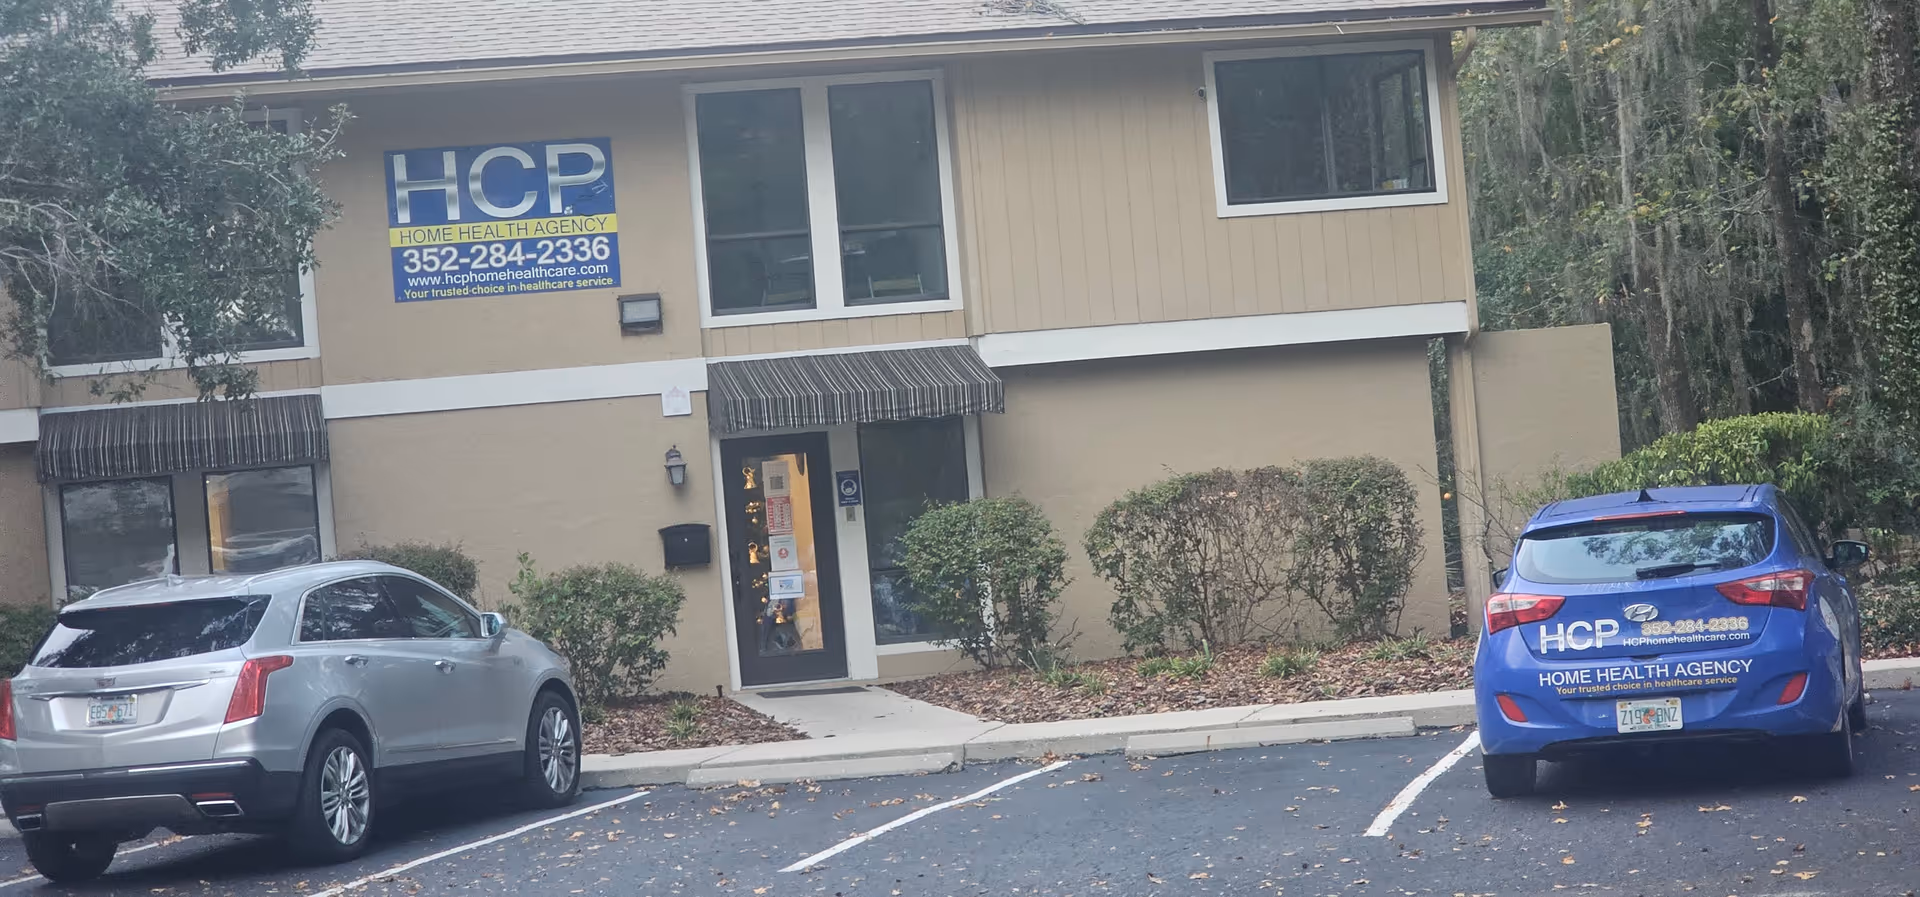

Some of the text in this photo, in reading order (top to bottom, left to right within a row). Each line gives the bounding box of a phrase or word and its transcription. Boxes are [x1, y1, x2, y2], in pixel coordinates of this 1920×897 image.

[393, 143, 606, 224] HCP
[400, 217, 608, 245] HOME HEALTH AGENCY
[402, 236, 611, 274] 352-284-2336
[404, 276, 613, 299] Your trusted choice in healthcare service
[408, 263, 608, 287] www.hcphomehealthcare.com
[1539, 619, 1620, 655] HCP
[1623, 632, 1751, 647] HCPhomehealthcare.com
[1641, 616, 1749, 637] 352-284-2336
[1539, 659, 1753, 687] HOME HEALTH AGENCY
[1556, 675, 1738, 695] Your trusted choice in healthcare service
